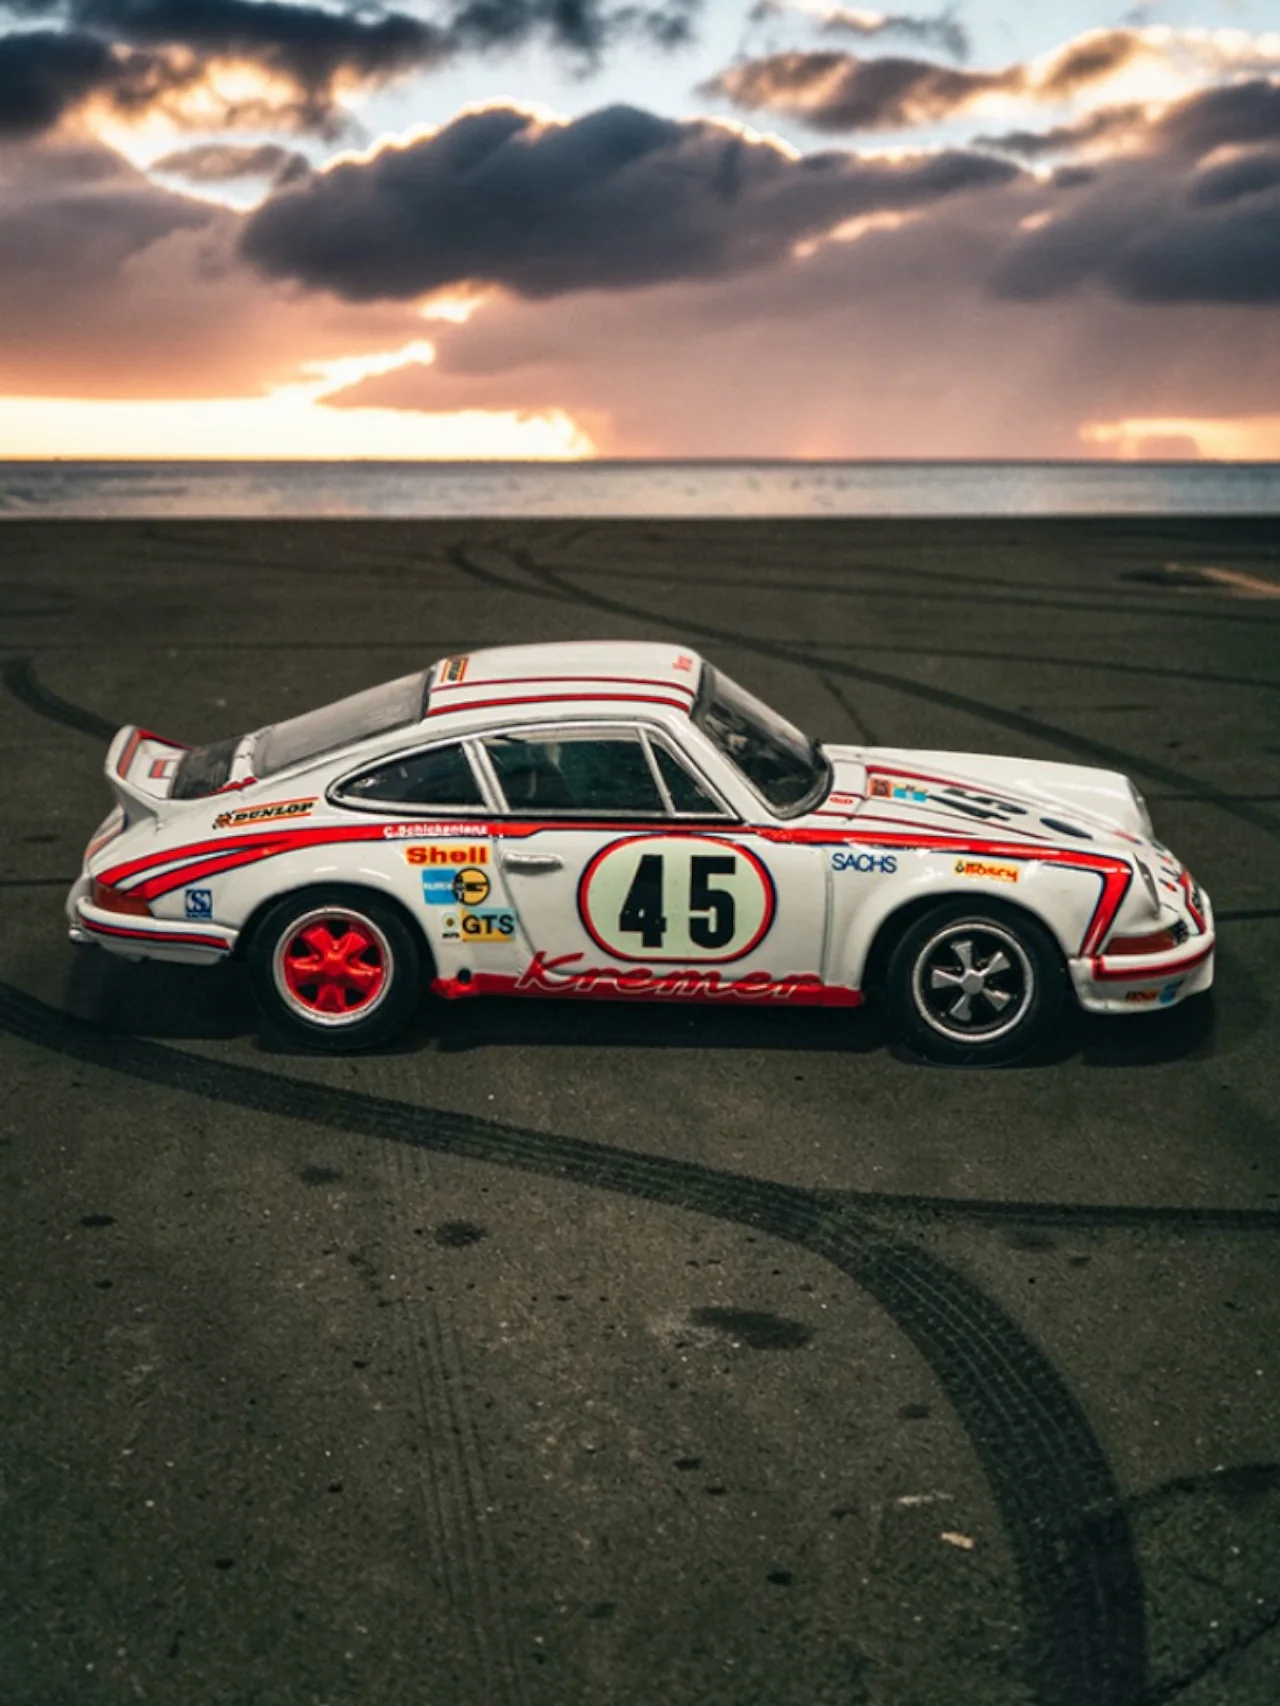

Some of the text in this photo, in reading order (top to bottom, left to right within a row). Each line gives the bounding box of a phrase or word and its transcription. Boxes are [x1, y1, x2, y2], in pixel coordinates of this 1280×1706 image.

[234, 801, 314, 822] DUNLOP
[406, 846, 488, 865] Shell
[831, 852, 897, 875] SACHS
[618, 853, 737, 949] 45
[462, 914, 515, 935] GTS
[514, 951, 824, 999] Kremer
